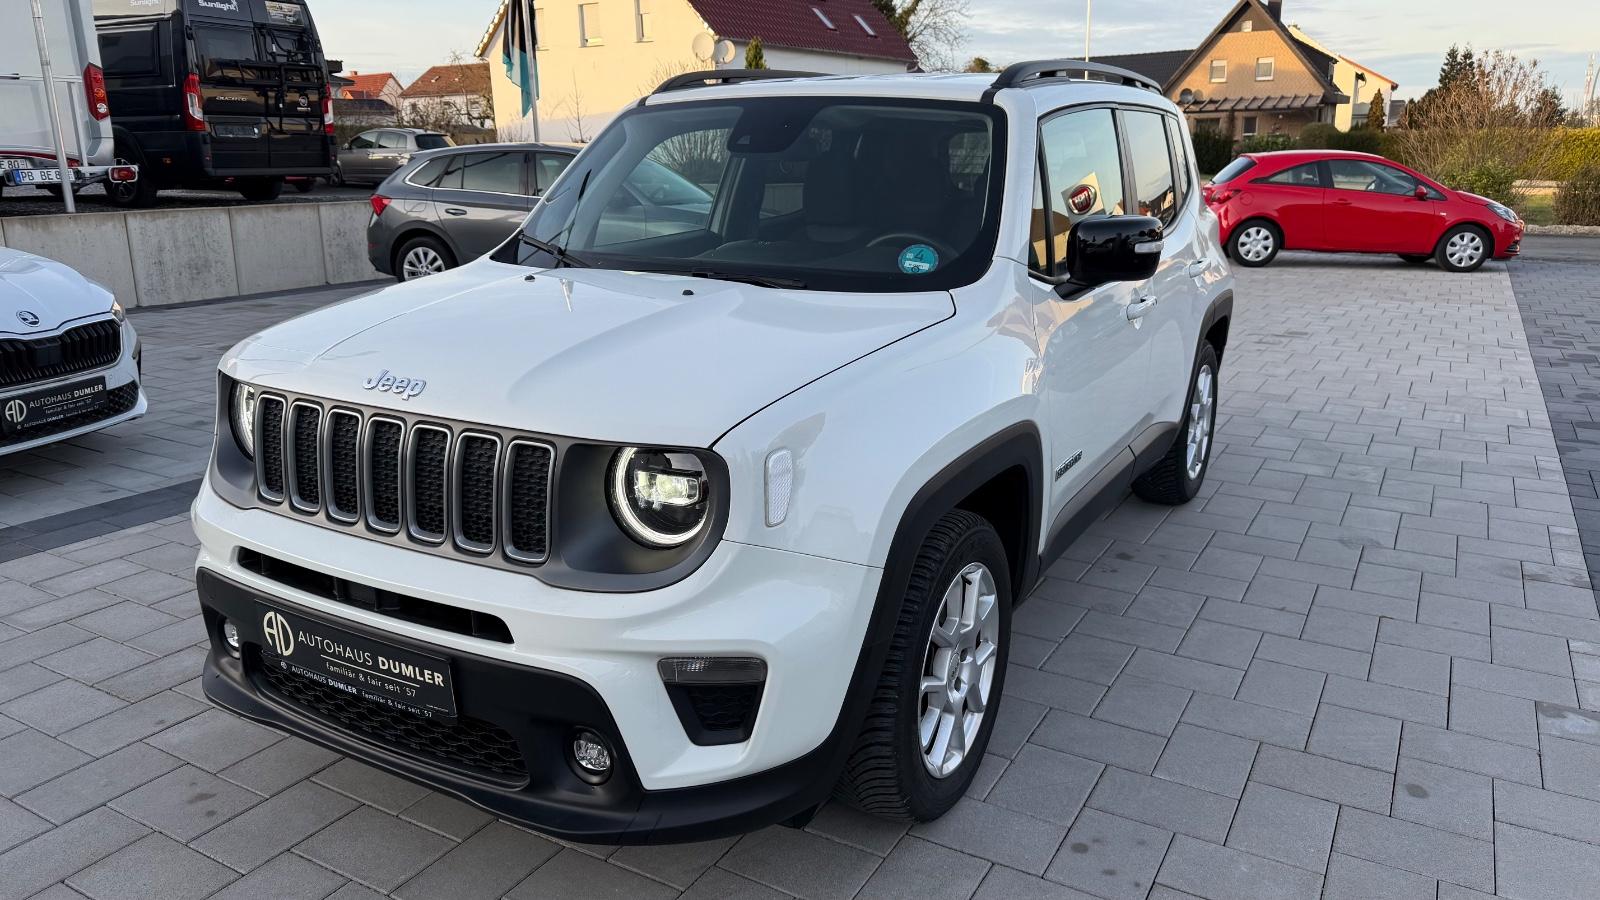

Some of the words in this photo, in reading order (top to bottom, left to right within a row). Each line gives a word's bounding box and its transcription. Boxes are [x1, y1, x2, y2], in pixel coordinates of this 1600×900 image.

[198, 0, 237, 12] Sunlight
[21, 171, 35, 181] PB
[40, 171, 53, 180] BE
[914, 249, 924, 261] 4
[29, 392, 72, 408] AUTOHAUS
[74, 384, 103, 397] DUMLER
[362, 369, 426, 401] Jeep
[298, 631, 373, 666] AUTOHAUS
[377, 656, 444, 687] DUMLER
[291, 665, 327, 684] AUTOHAUS
[328, 679, 358, 695] DUMLER
[326, 661, 356, 678] familiär
[359, 673, 365, 682] &
[367, 676, 382, 687] fair
[385, 683, 401, 693] seit
